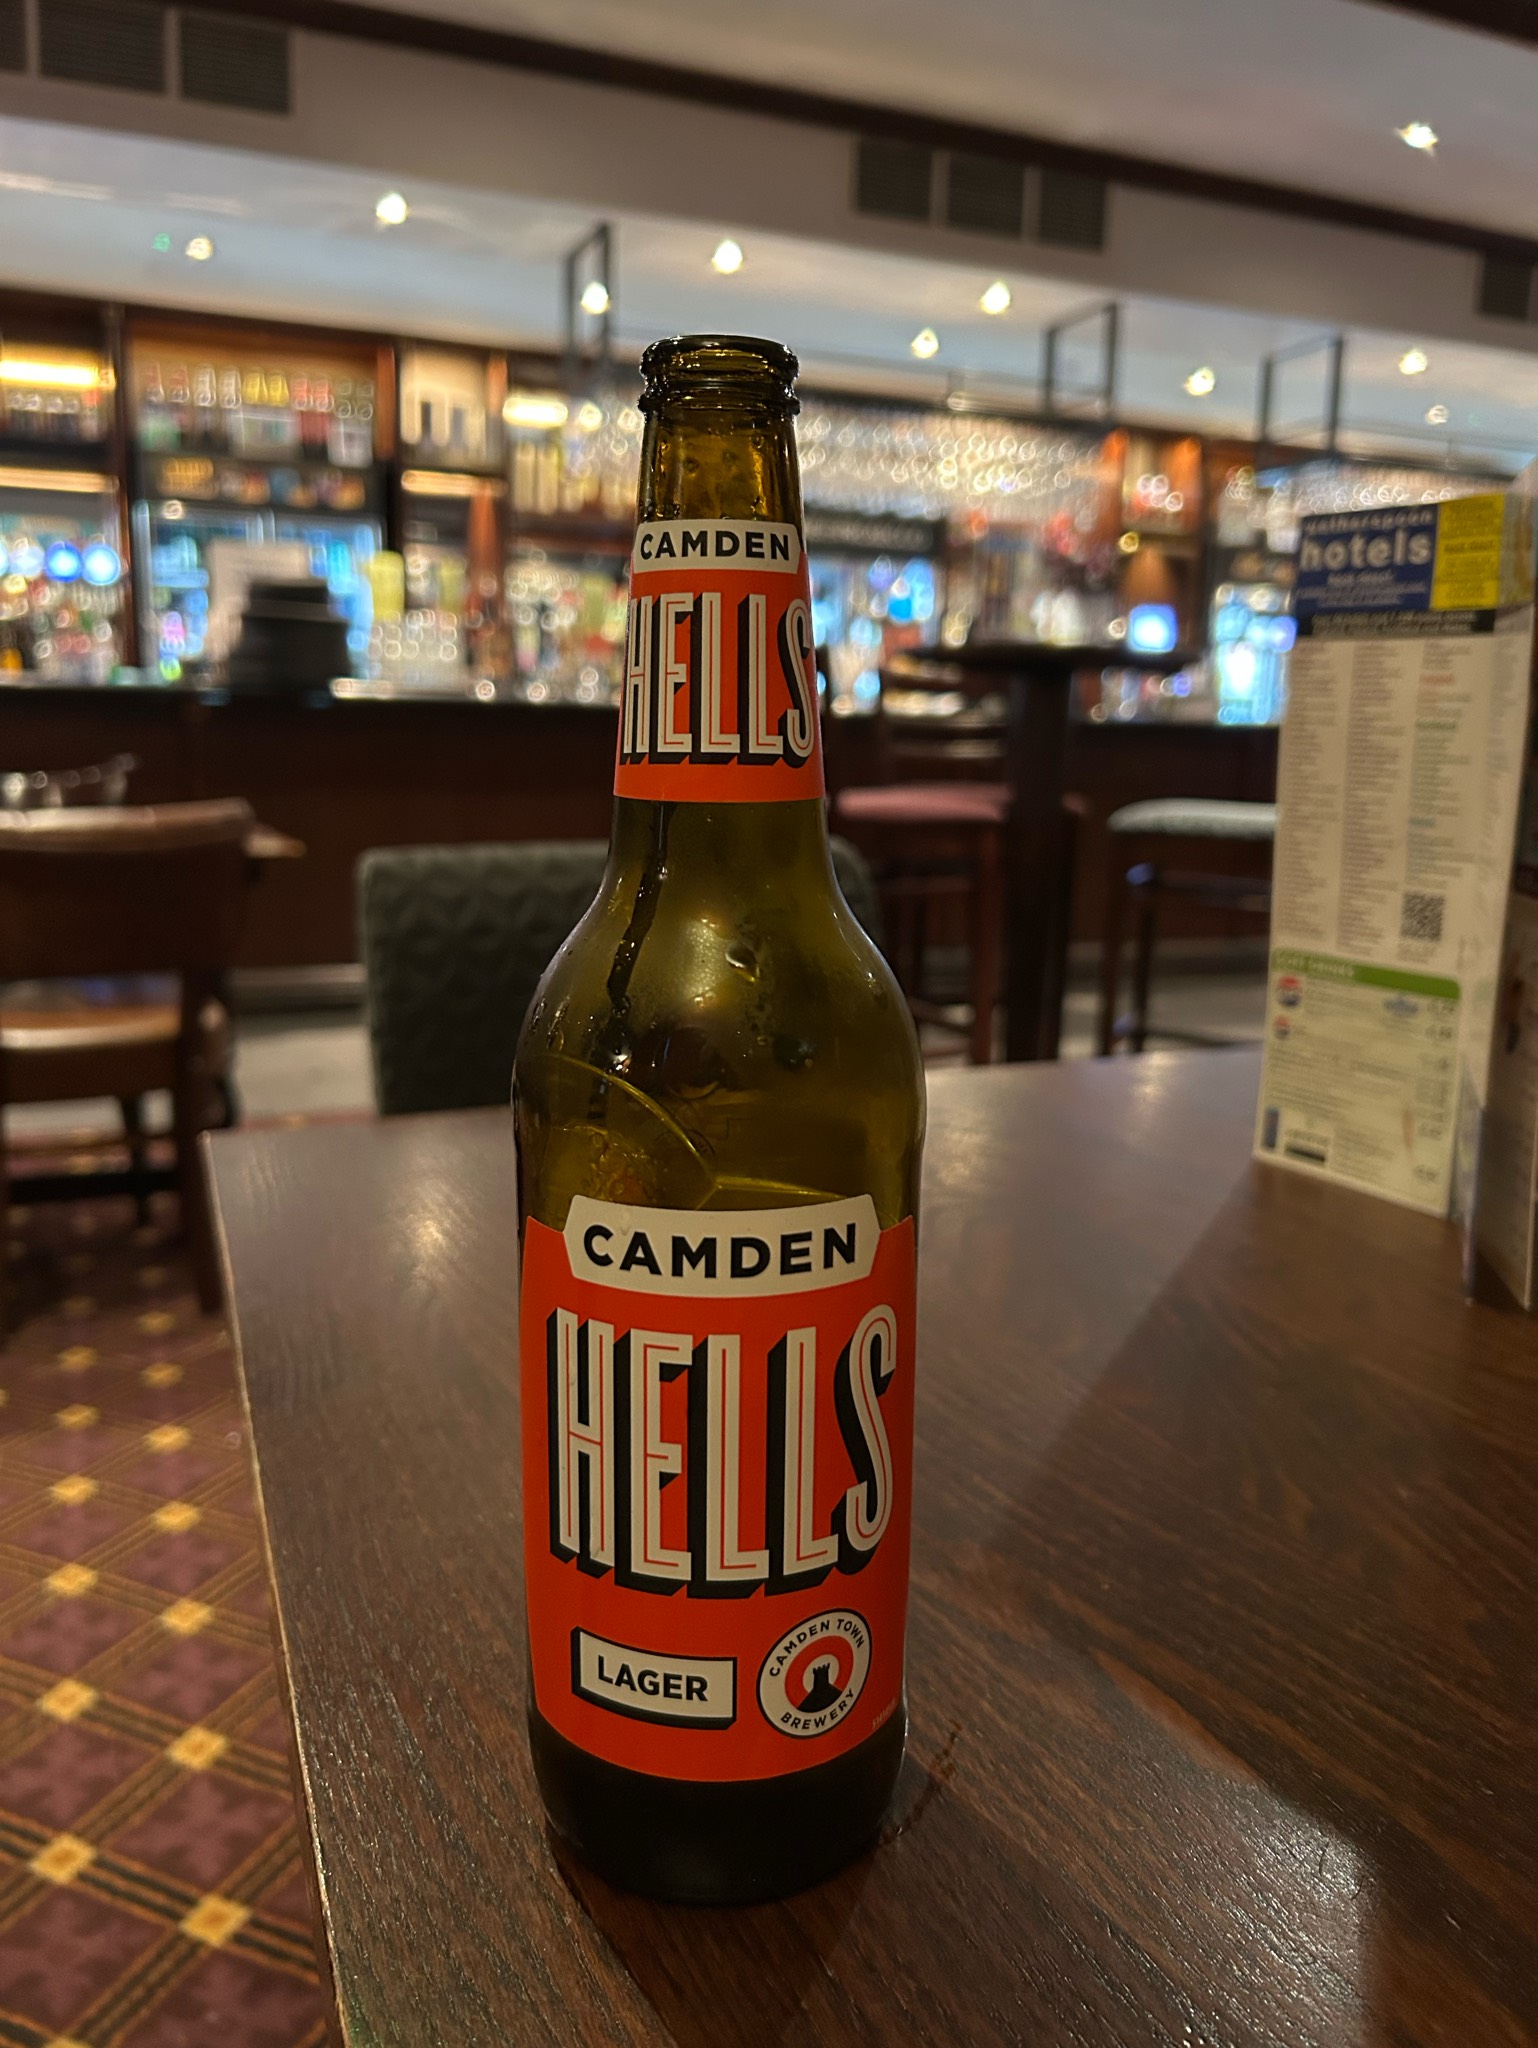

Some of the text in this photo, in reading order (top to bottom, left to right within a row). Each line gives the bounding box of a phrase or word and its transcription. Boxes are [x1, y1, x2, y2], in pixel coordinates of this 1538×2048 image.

[640, 530, 789, 561] CAMDEN
[1300, 529, 1431, 571] hotels
[619, 592, 815, 768] HELLS
[583, 1222, 857, 1279] CAMDEN
[547, 1304, 898, 1599] HELLS
[769, 1618, 865, 1677] CAMDEN TOWN
[598, 1655, 708, 1702] LAGER
[780, 1688, 854, 1730] BREWERY
